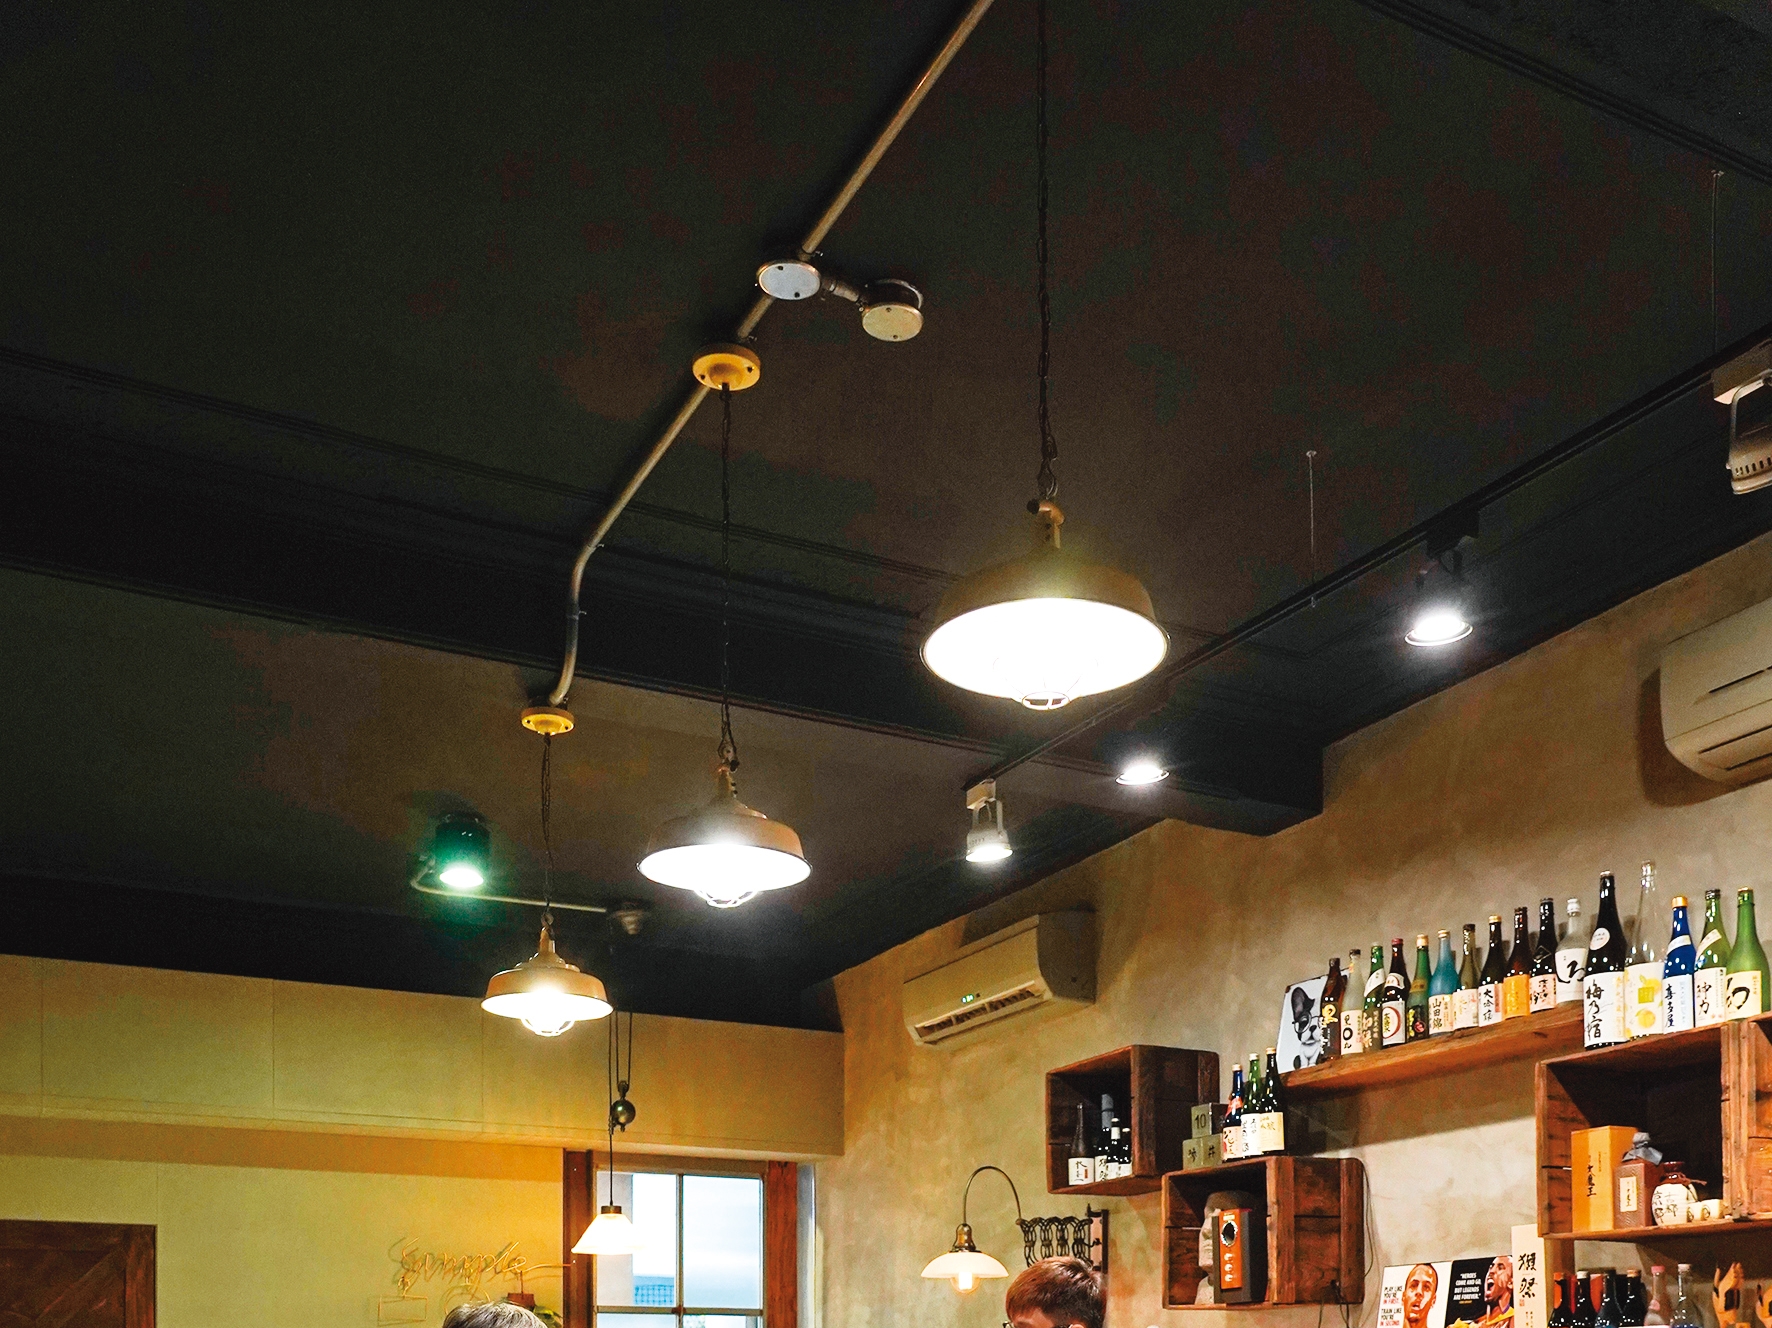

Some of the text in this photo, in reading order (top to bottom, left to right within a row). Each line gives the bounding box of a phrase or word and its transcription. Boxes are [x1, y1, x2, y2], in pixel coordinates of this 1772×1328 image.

[1585, 978, 1605, 1041] 梅乃宿
[1194, 1113, 1207, 1129] 10
